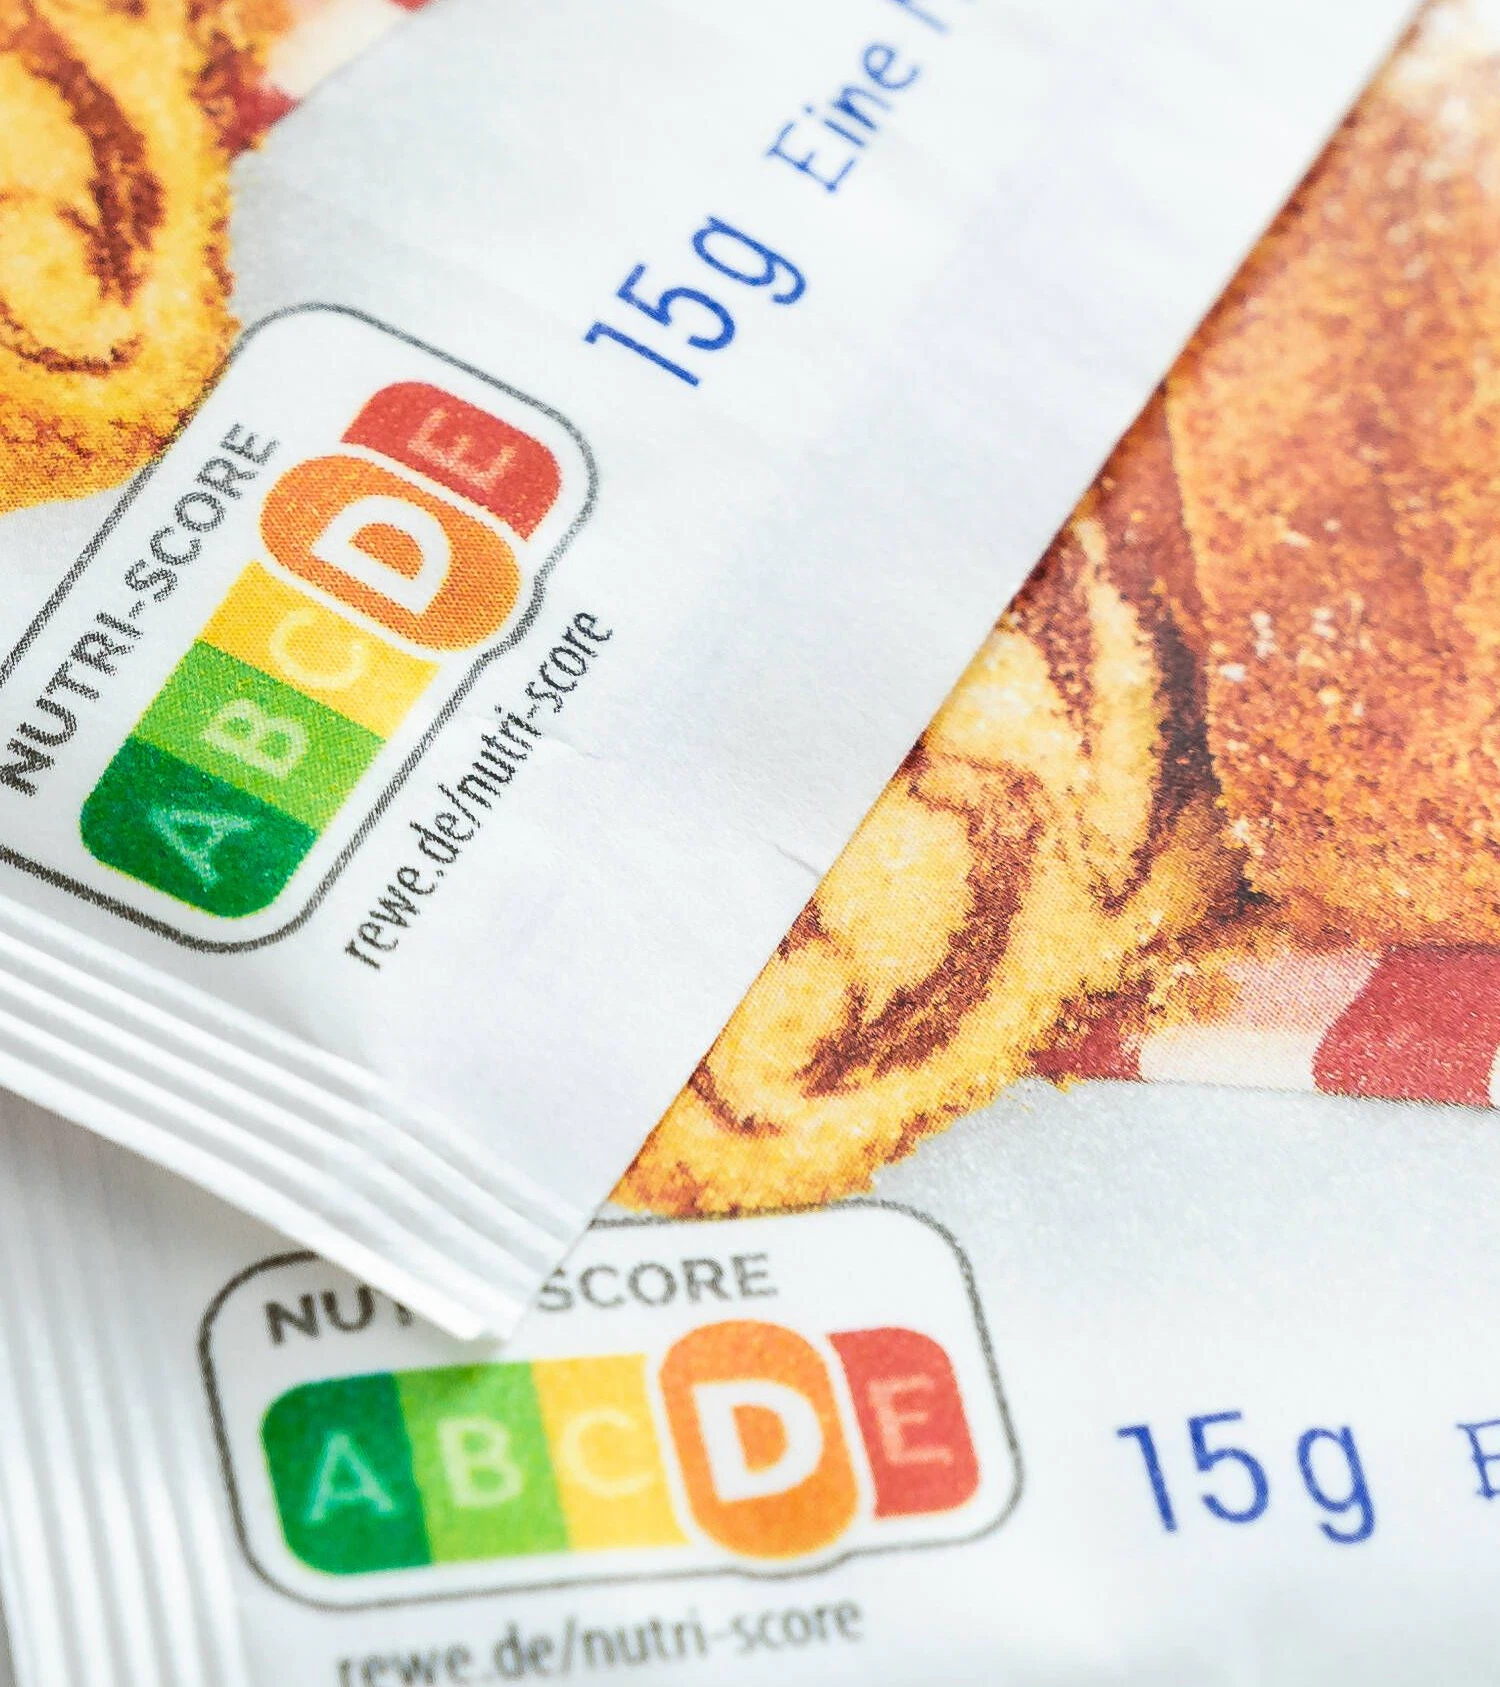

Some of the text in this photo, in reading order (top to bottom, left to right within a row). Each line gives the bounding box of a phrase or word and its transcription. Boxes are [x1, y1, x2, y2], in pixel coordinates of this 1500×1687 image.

[766, 39, 922, 194] Eine
[583, 216, 807, 387] 15g
[344, 609, 614, 973] rewe.de/nutri-score
[1114, 1410, 1376, 1544] 15g
